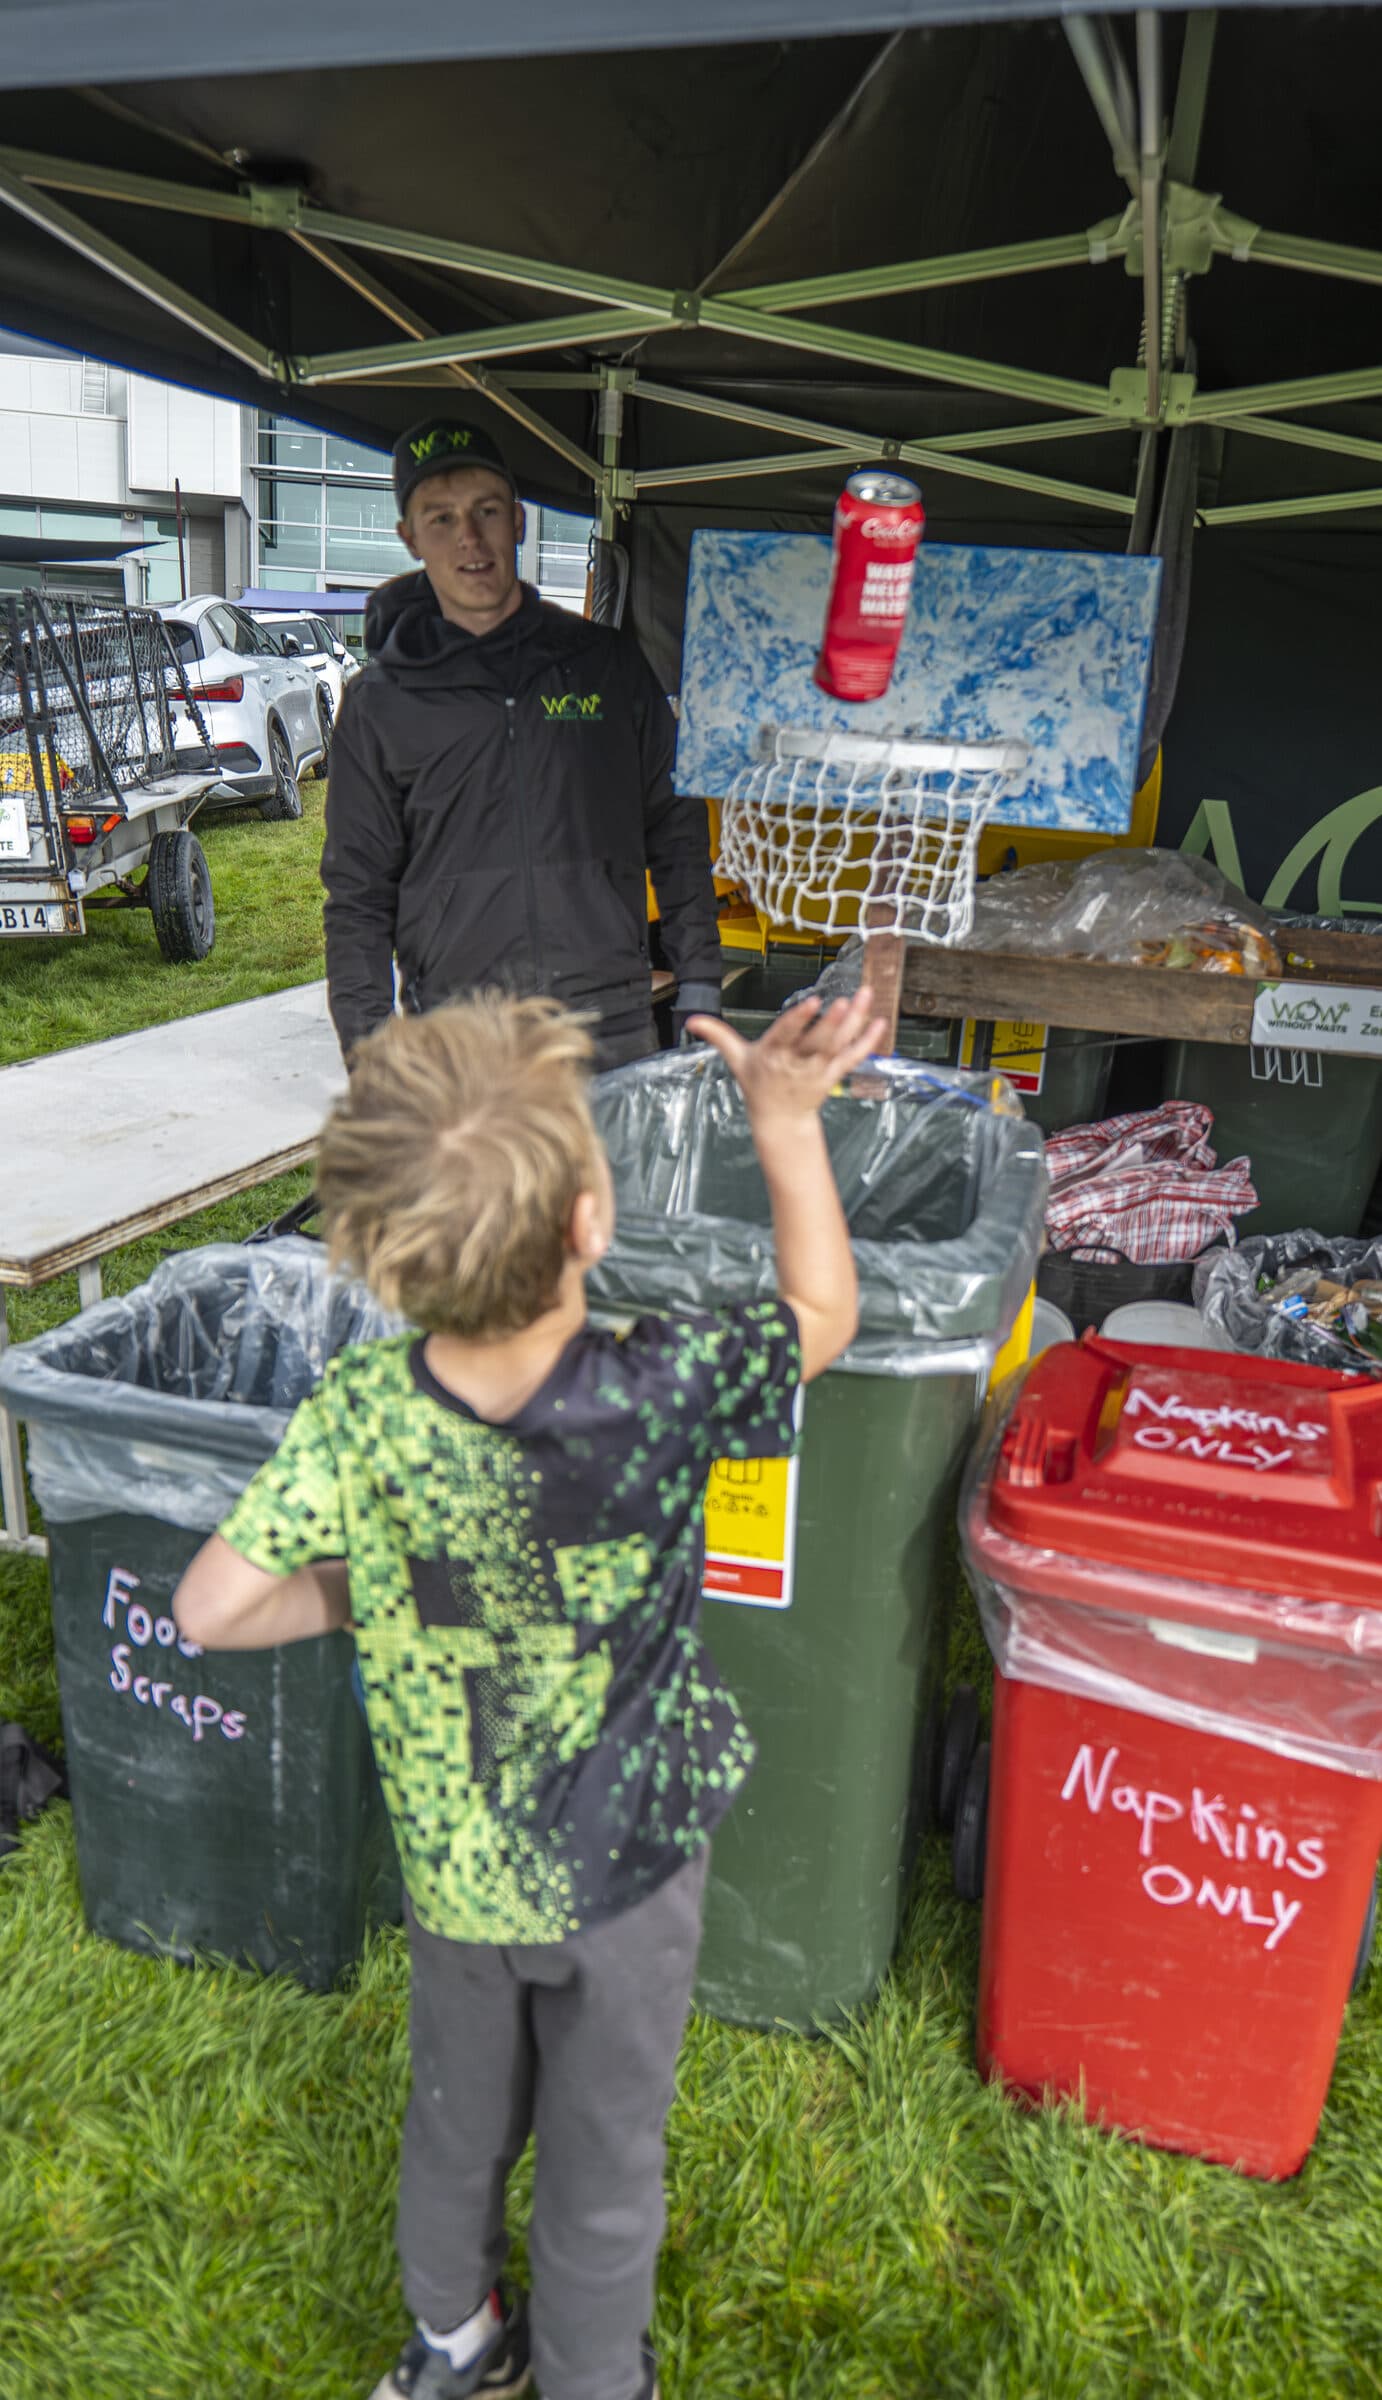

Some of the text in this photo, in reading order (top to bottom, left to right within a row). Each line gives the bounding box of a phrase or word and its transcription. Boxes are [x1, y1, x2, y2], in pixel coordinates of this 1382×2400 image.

[0, 908, 46, 929] B14
[1267, 1020, 1348, 1034] WITHOUT WASTE
[1271, 998, 1350, 1024] WOW
[1123, 1388, 1328, 1440] Napkins
[1134, 1427, 1293, 1471] ONLY
[110, 1643, 247, 1742] Scraps
[1061, 1744, 1327, 1880] Napkins
[1142, 1865, 1302, 1950] ONLY
